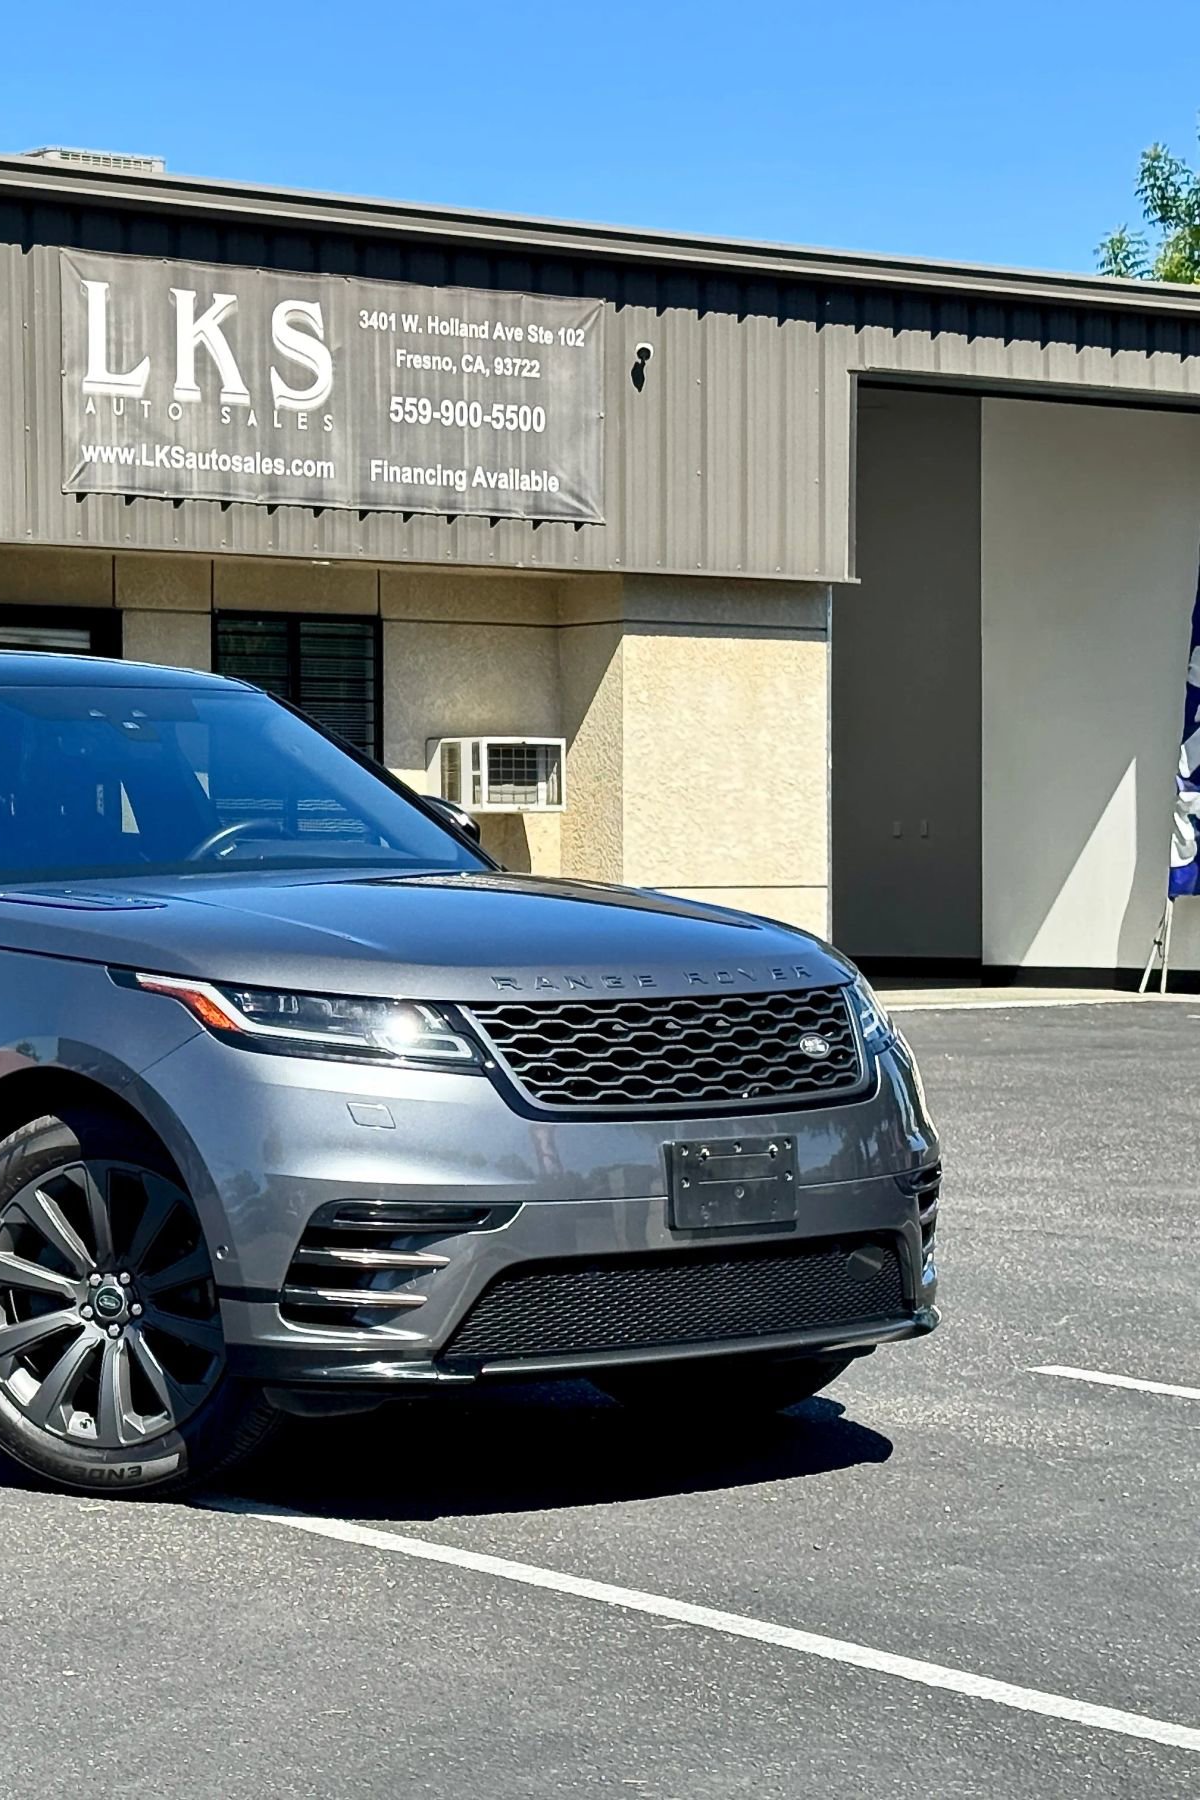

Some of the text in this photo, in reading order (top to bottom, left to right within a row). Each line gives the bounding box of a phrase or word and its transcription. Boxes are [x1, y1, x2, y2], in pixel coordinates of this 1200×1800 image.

[81, 280, 333, 411] LKS
[359, 310, 585, 347] 3401 W. Holland Ave Ste 102
[396, 349, 541, 378] Fresno, CA, 93722
[85, 396, 334, 432] AUTO SALES
[389, 396, 546, 433] 559-900-5500
[81, 443, 336, 479] www.LKSautosales.com
[370, 459, 560, 493] Financing Available
[489, 964, 814, 991] RANGE ROVER
